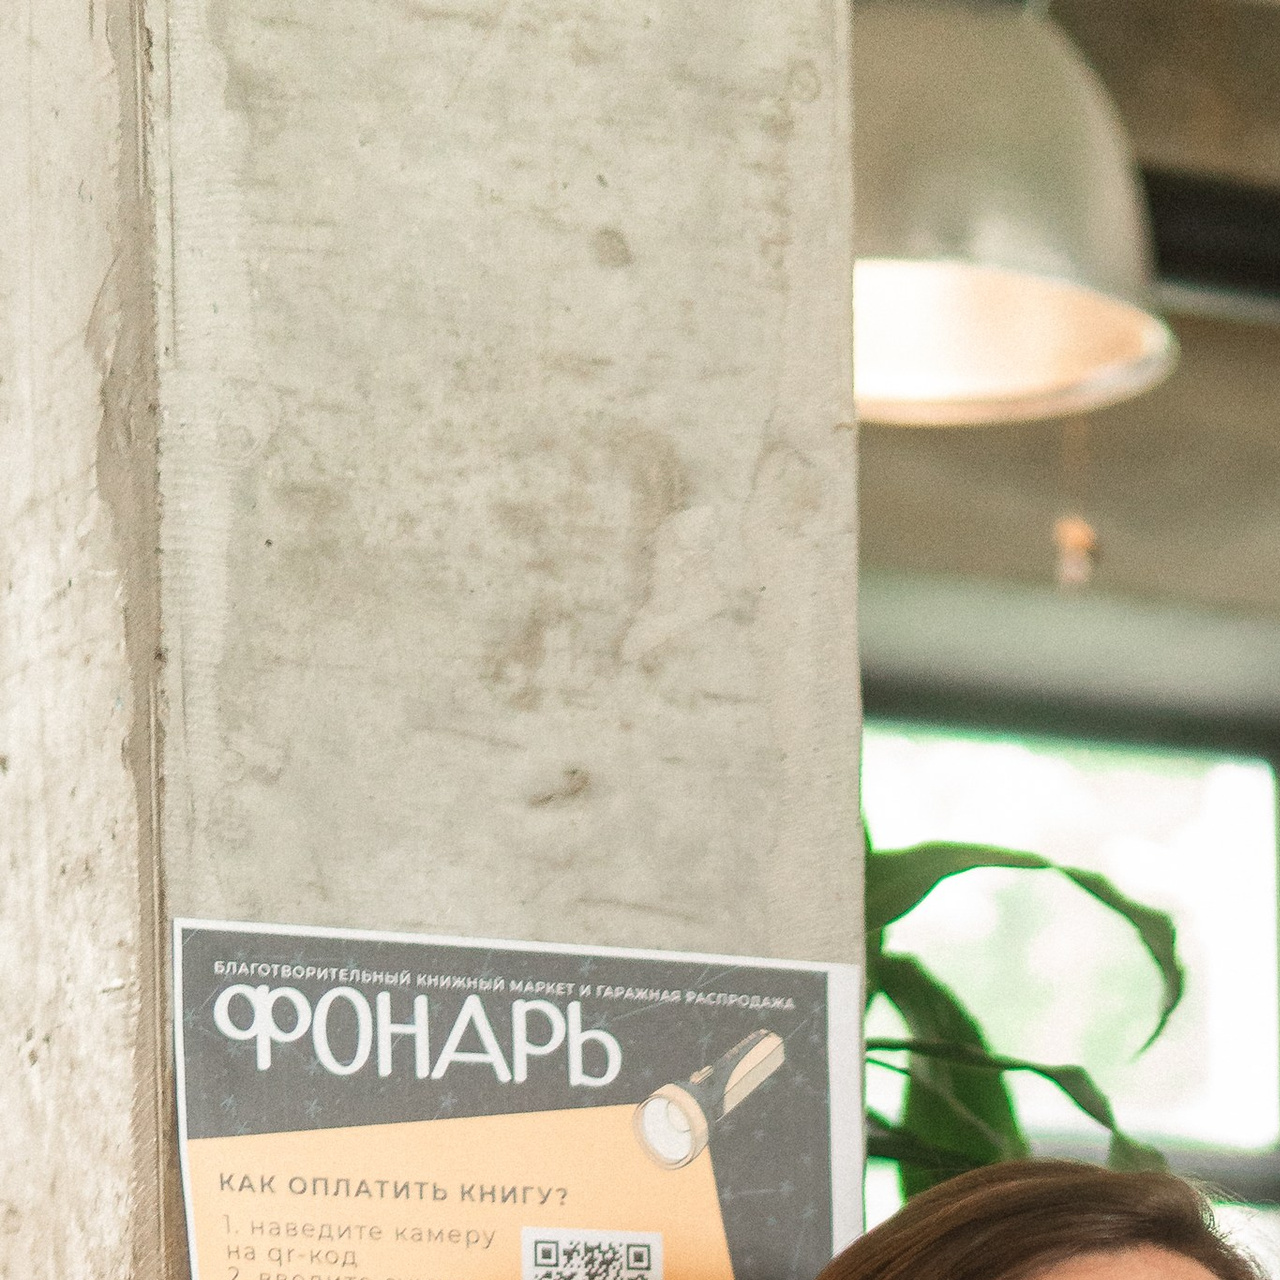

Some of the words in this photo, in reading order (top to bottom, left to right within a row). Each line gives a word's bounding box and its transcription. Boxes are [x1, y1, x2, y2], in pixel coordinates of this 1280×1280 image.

[213, 960, 412, 986] БЛАГОТВОРИТЕЛЬНЫЙ
[416, 973, 505, 991] КНИЖНЫЙ
[509, 979, 575, 996] МАРКЕТ
[579, 984, 591, 997] И
[596, 985, 681, 1002] ГАРАЖНАЯ
[684, 989, 796, 1010] РАСПРОДАЖА
[213, 983, 622, 1087] ФОНАРЬ
[219, 1172, 275, 1193] КАК
[288, 1176, 448, 1201] ОПЛАТИТЬ
[460, 1182, 568, 1206] КНИГУ?
[222, 1214, 239, 1234] 1.
[250, 1220, 383, 1242] наведите
[395, 1227, 496, 1249] камеру
[226, 1244, 256, 1262] на
[267, 1248, 358, 1268] qr-код
